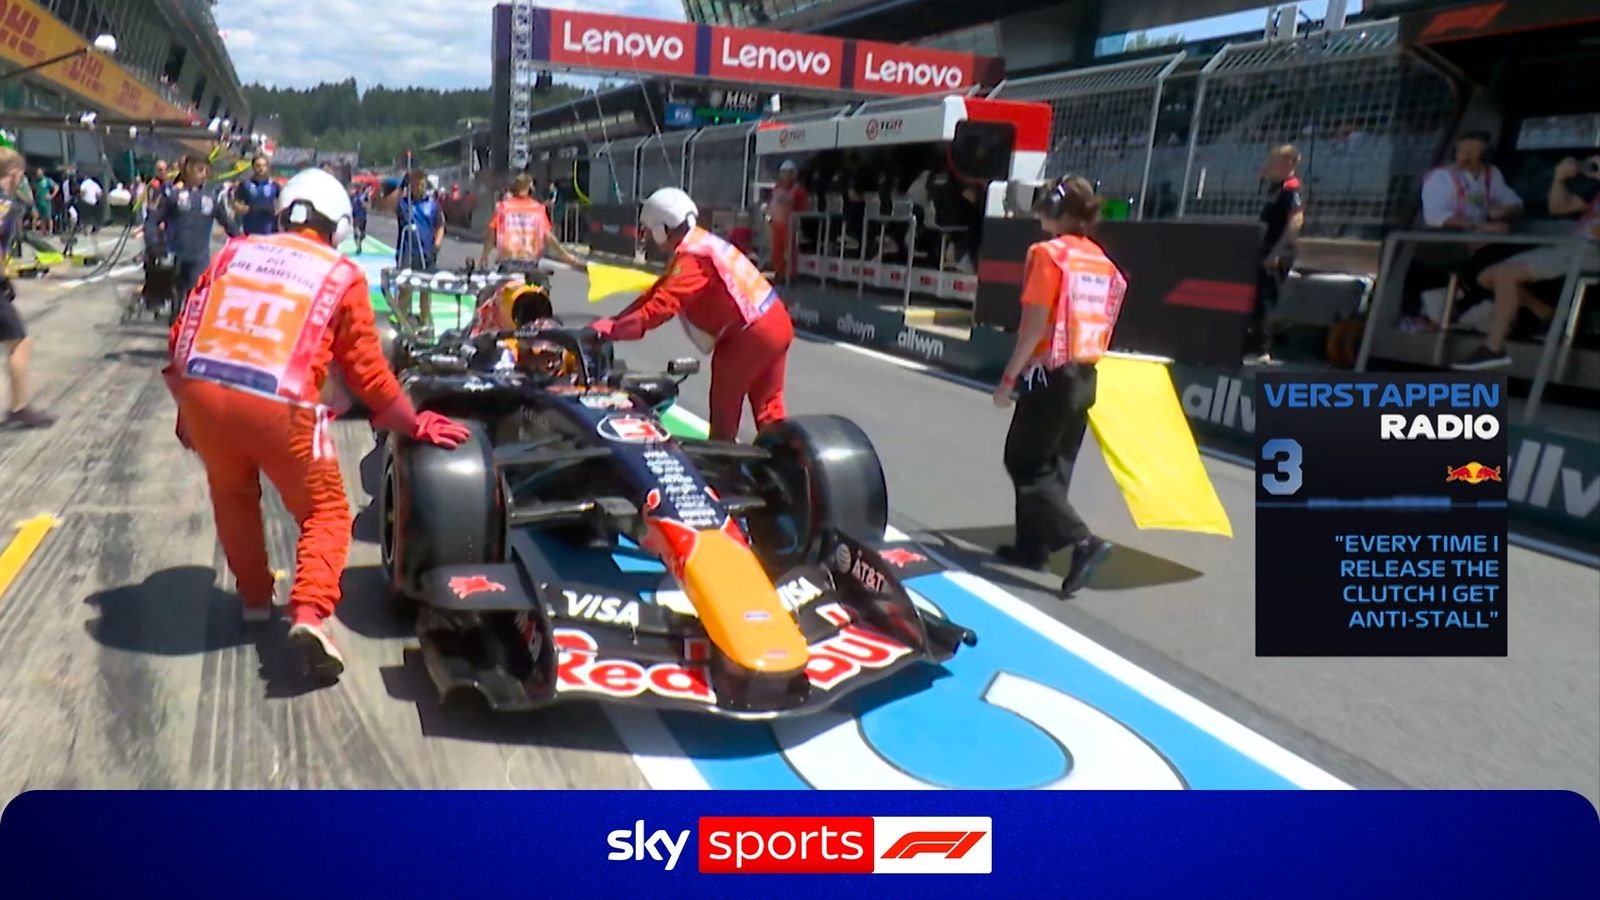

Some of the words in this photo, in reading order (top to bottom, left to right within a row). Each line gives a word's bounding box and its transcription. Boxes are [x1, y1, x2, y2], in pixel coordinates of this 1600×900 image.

[563, 19, 684, 61] Lenovo
[722, 36, 831, 76] Lenovo
[864, 52, 963, 88] Lenovo
[836, 311, 876, 342] allwyn
[897, 329, 944, 360] allwyn
[852, 557, 886, 593] AT&T
[562, 589, 640, 627] VISA
[553, 628, 717, 704] Red
